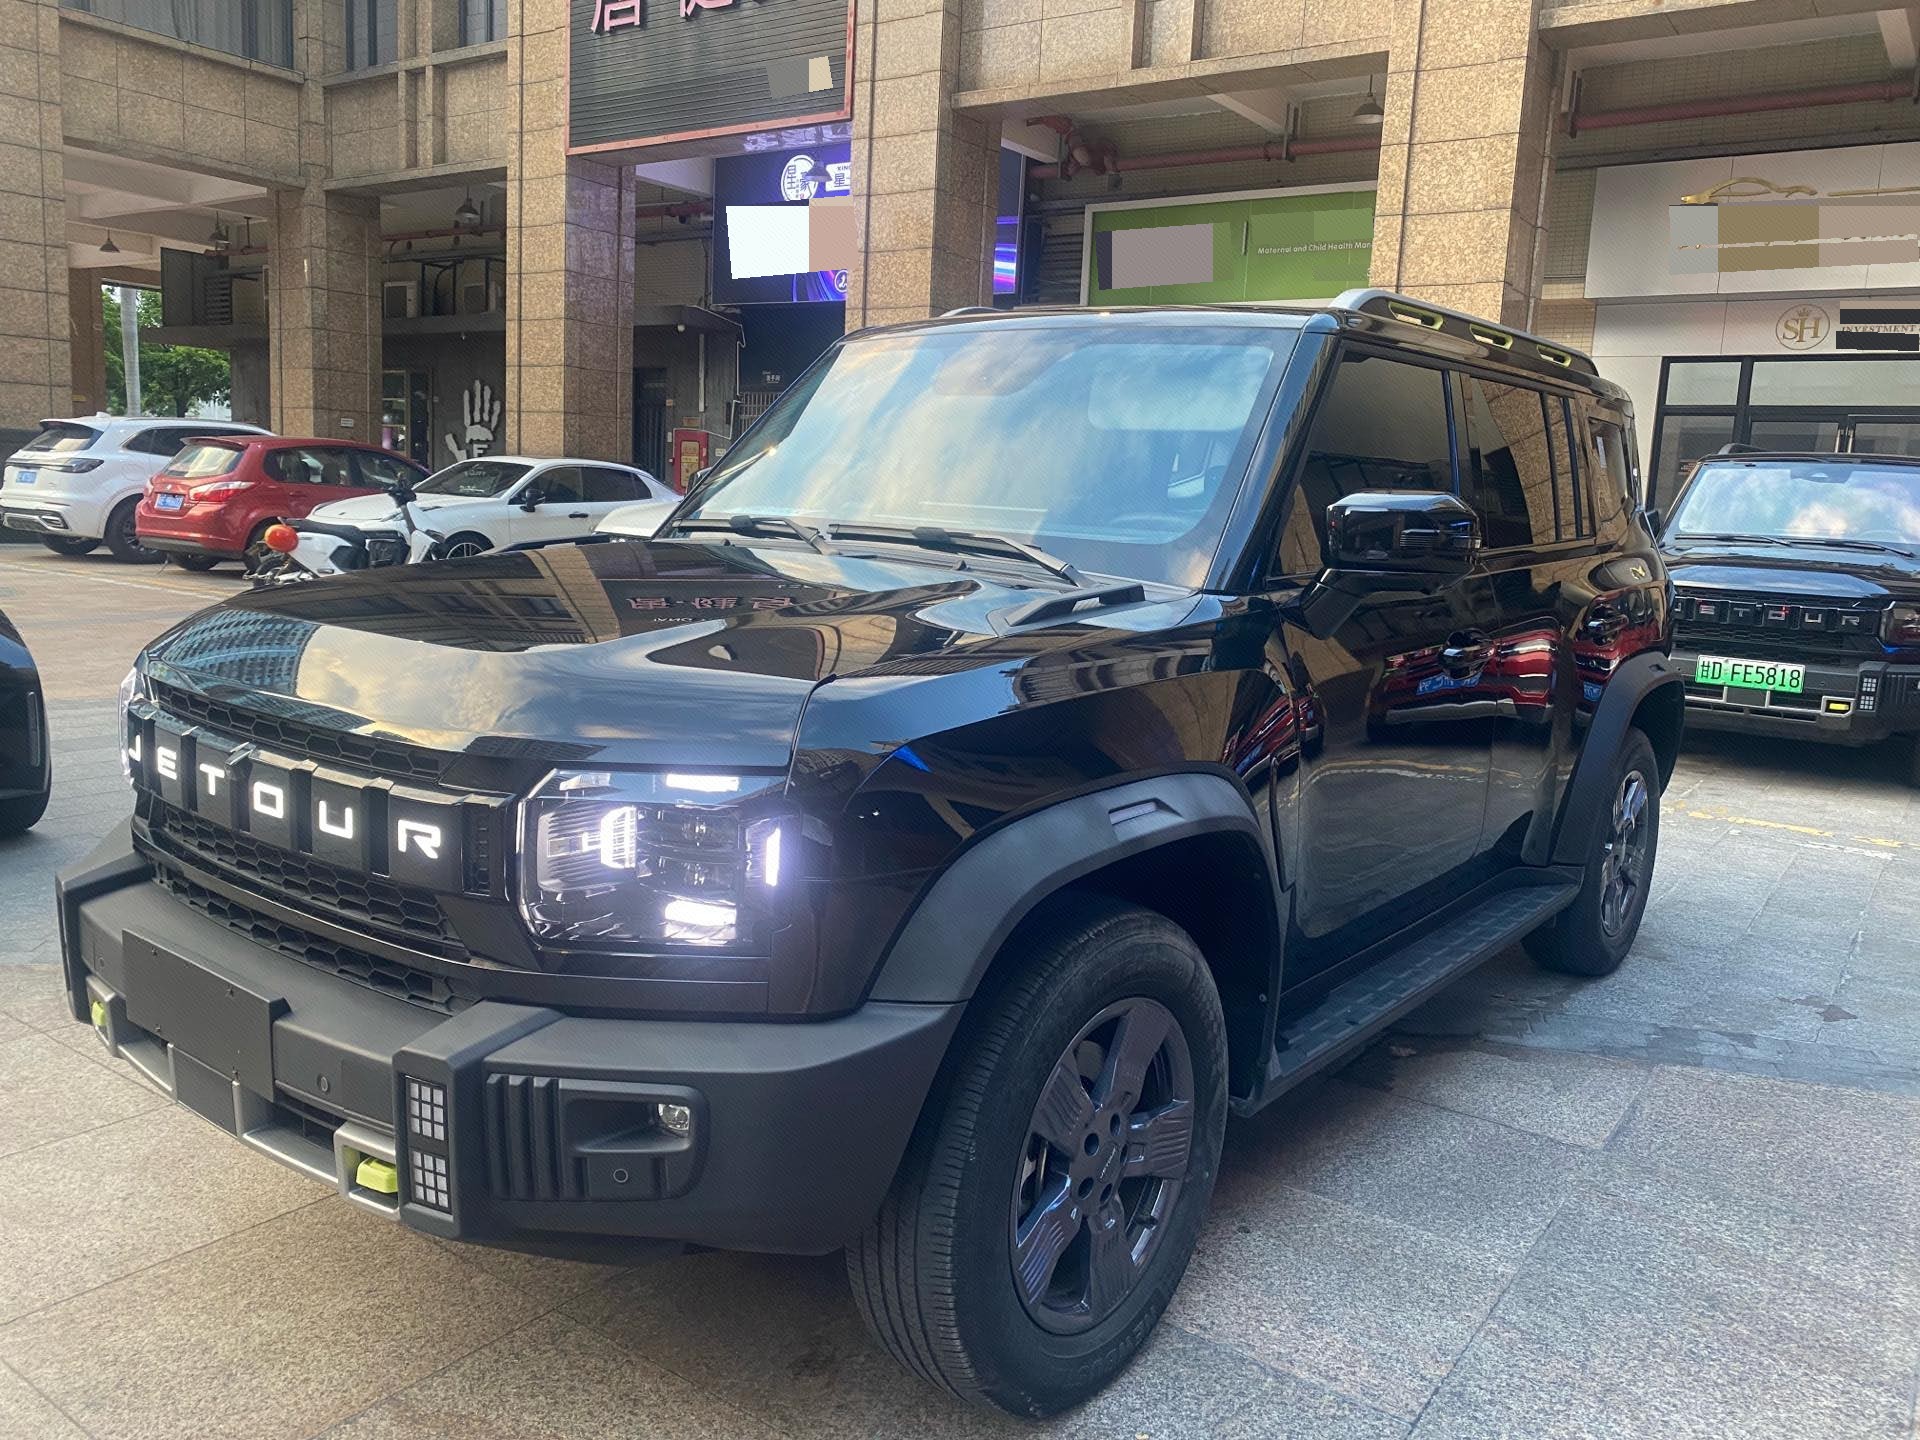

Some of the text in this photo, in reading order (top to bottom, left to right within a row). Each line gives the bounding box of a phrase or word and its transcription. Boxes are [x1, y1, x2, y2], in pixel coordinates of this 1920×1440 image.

[1257, 246, 1292, 255] Maternal
[1293, 244, 1307, 253] and
[1308, 243, 1327, 251] Child
[1328, 242, 1353, 250] Health
[127, 734, 442, 860] JETOUR
